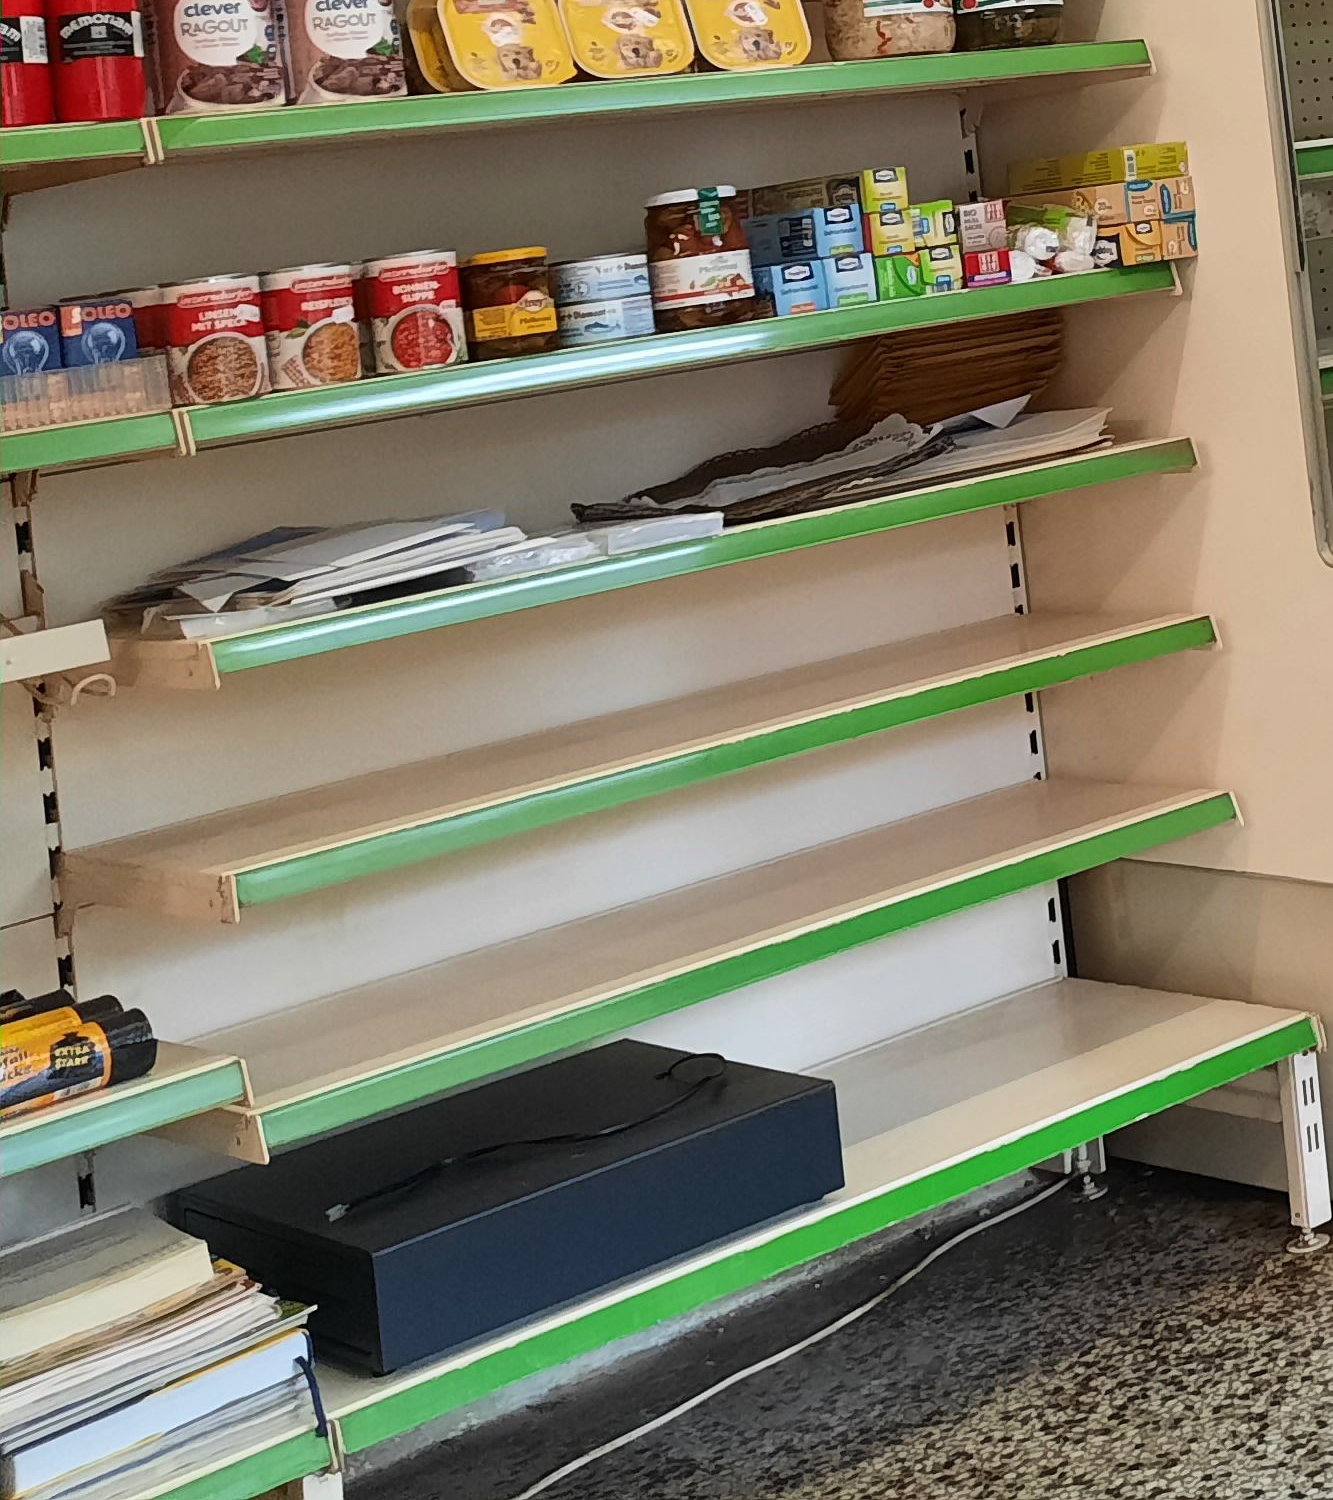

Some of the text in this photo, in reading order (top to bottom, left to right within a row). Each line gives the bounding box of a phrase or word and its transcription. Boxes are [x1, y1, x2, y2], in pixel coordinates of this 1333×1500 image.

[183, 1, 241, 18] clever
[180, 18, 249, 37] RAGOUT
[312, 13, 377, 32] RAGOUT
